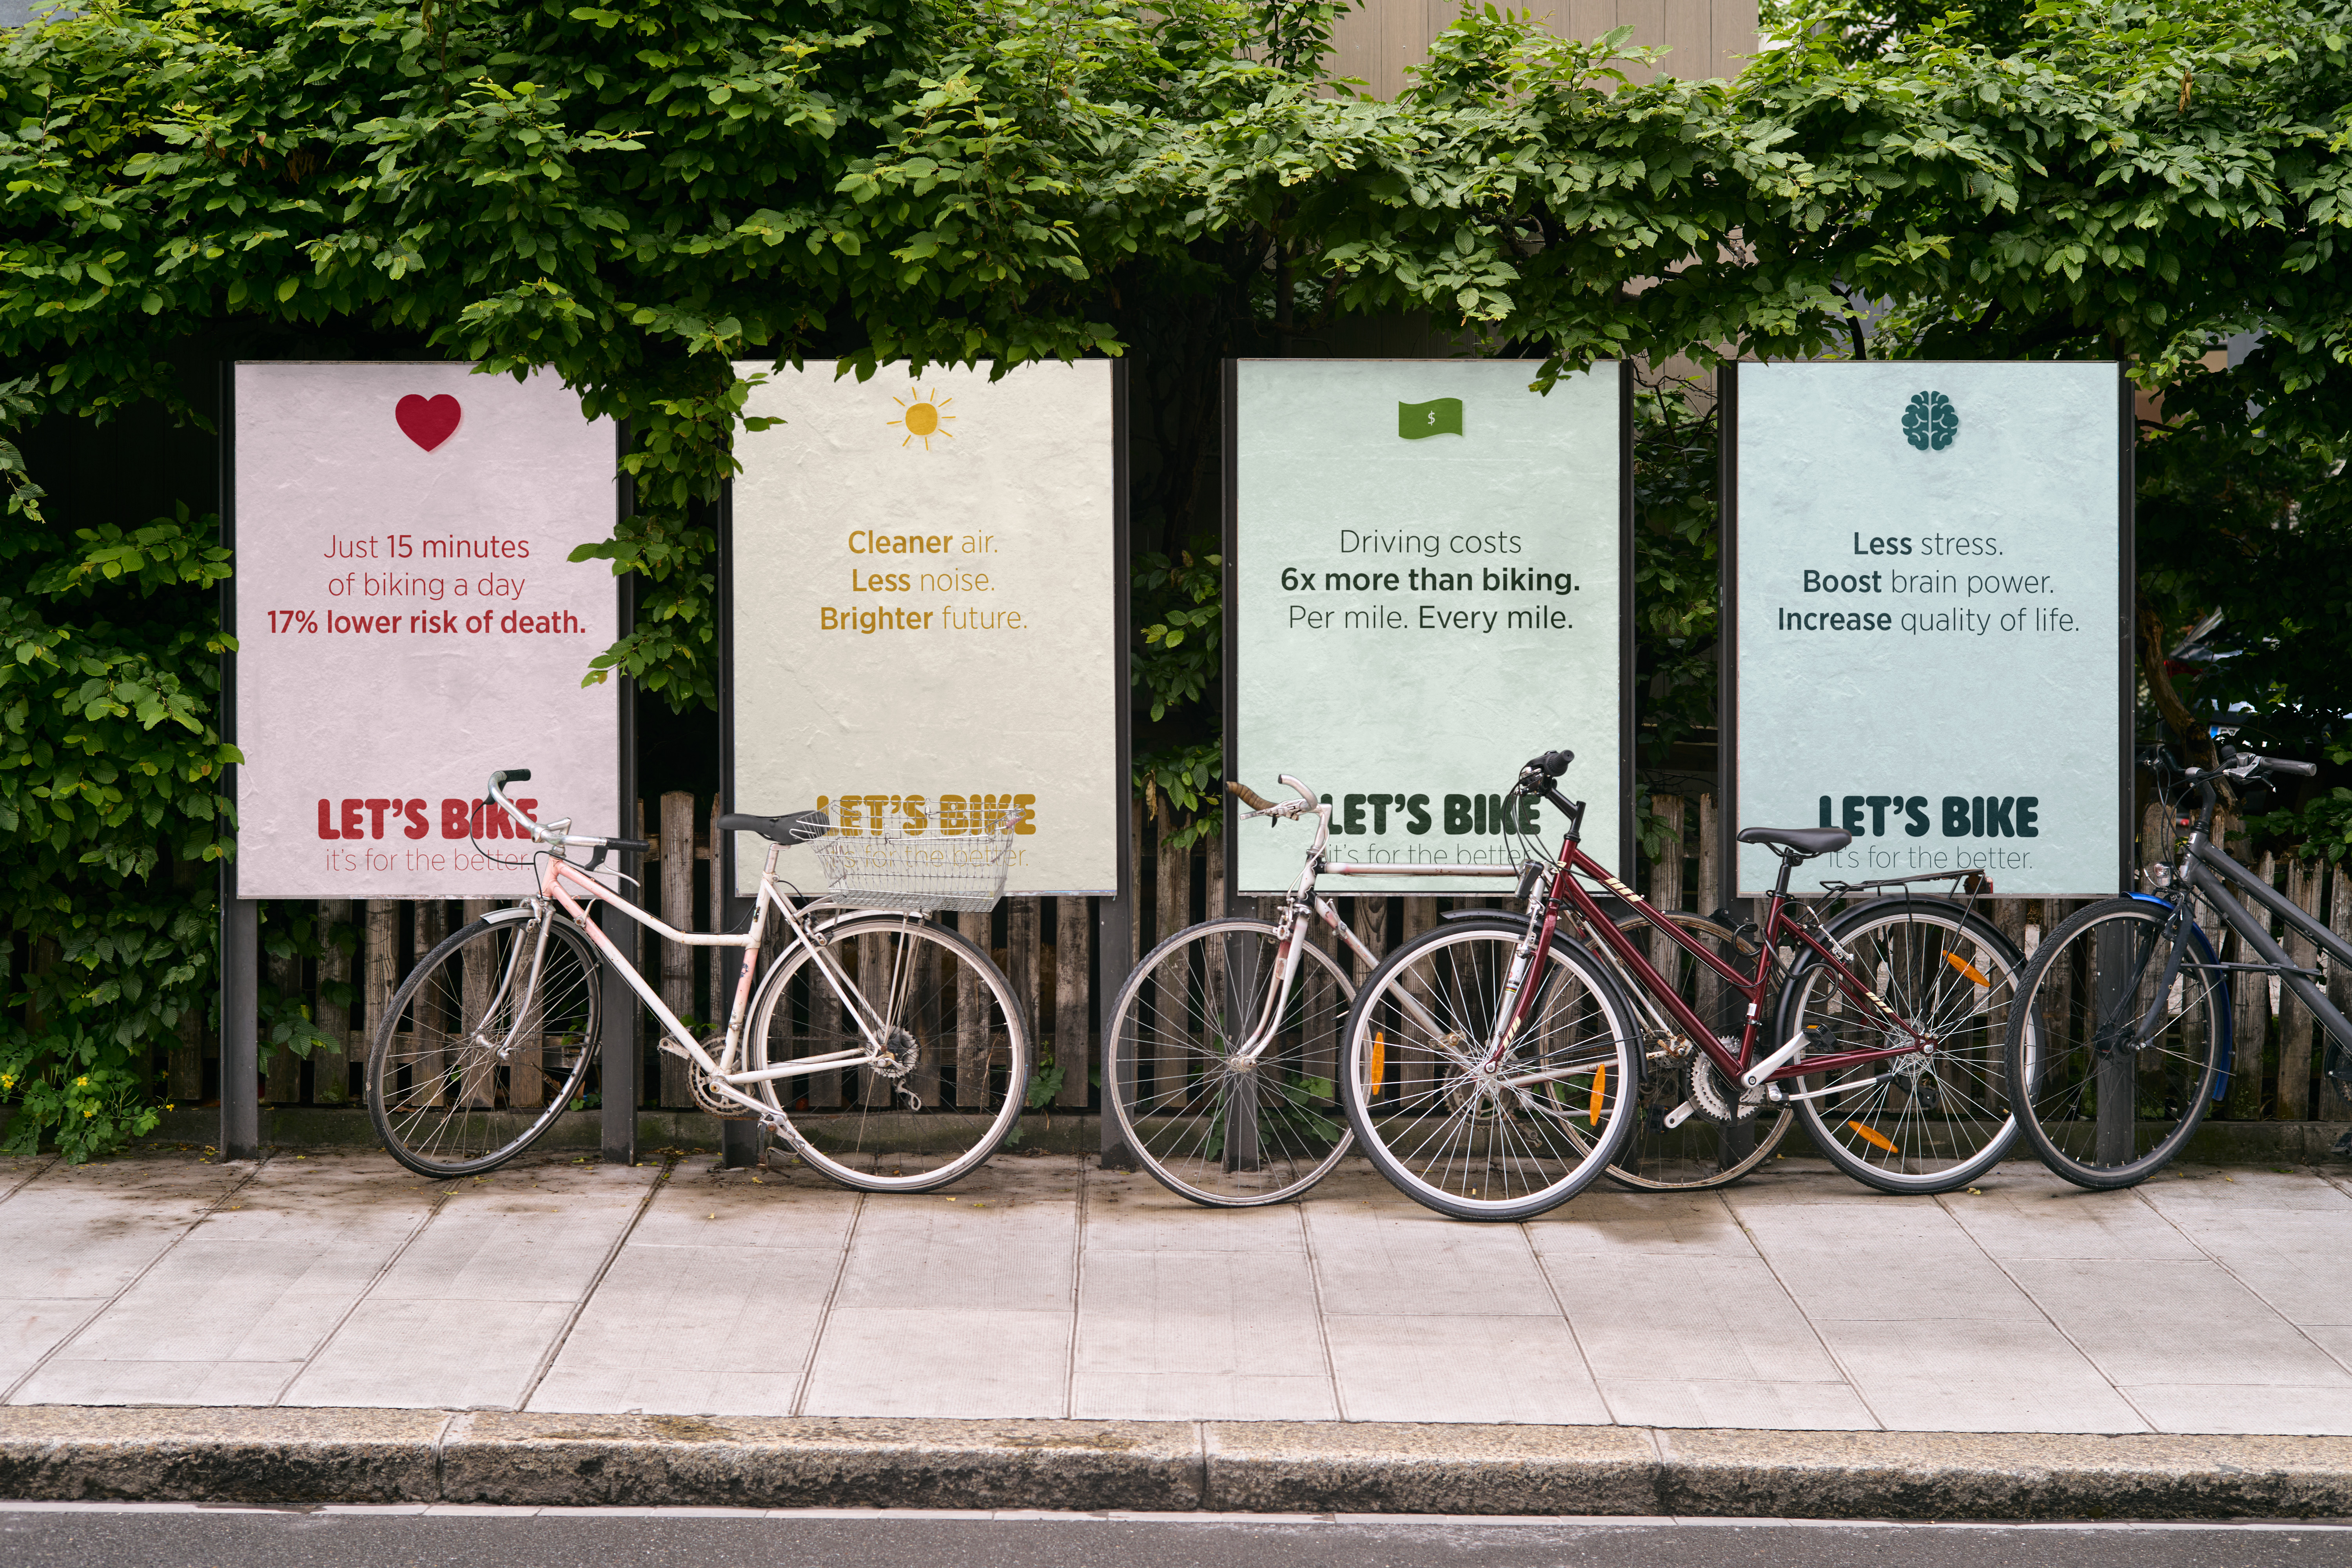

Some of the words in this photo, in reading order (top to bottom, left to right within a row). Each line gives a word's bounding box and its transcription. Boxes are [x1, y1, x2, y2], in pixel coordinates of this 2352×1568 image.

[324, 535, 378, 558] Just
[387, 535, 412, 558] 15
[423, 535, 529, 558] minutes
[849, 530, 953, 554] Cleaner
[962, 530, 997, 554] air.
[1341, 530, 1439, 557] Driving
[1450, 531, 1521, 554] costs
[1855, 532, 1912, 555] Less
[1921, 533, 2003, 555] stress.
[329, 572, 355, 596] of
[365, 572, 444, 600] biking
[455, 579, 467, 596] a
[478, 572, 525, 601] day
[853, 569, 910, 592] Less
[921, 568, 994, 592] noise.
[1281, 567, 1316, 591] 6x
[1326, 573, 1399, 591] more
[1408, 568, 1472, 591] than
[1483, 568, 1579, 595] biking.
[1804, 570, 1882, 593] Boost
[1893, 569, 1956, 593] brain
[1968, 576, 2053, 597] power.
[268, 610, 318, 634] 17%
[328, 610, 402, 634] lower
[411, 610, 458, 634] risk
[466, 610, 493, 633] of
[501, 610, 586, 633] death.
[821, 606, 933, 634] Brighter
[942, 606, 1027, 630] future.
[1290, 606, 1334, 629] Per
[1345, 605, 1408, 629] mile.
[1420, 606, 1497, 633] Every
[1508, 605, 1573, 629] mile.
[1779, 608, 1891, 631] Increase
[1902, 608, 1991, 636] quality
[2001, 608, 2027, 632] of
[2037, 608, 2079, 632] life.
[318, 798, 429, 840] LET'S
[441, 798, 538, 840] BIKE
[940, 794, 1036, 835] BIKE
[1444, 793, 1541, 835] BIKE
[1820, 795, 1930, 837] LET'S
[1942, 796, 2039, 838] BIKE
[327, 849, 356, 871] it's
[365, 848, 397, 871] for
[406, 848, 445, 871] the
[455, 848, 530, 871] better.
[864, 845, 897, 867] for
[905, 844, 944, 867] the
[1367, 843, 1400, 864] for
[1408, 843, 1447, 864] the
[1868, 845, 1900, 868] for
[1908, 846, 1947, 869] the
[1957, 846, 2032, 869] better.
